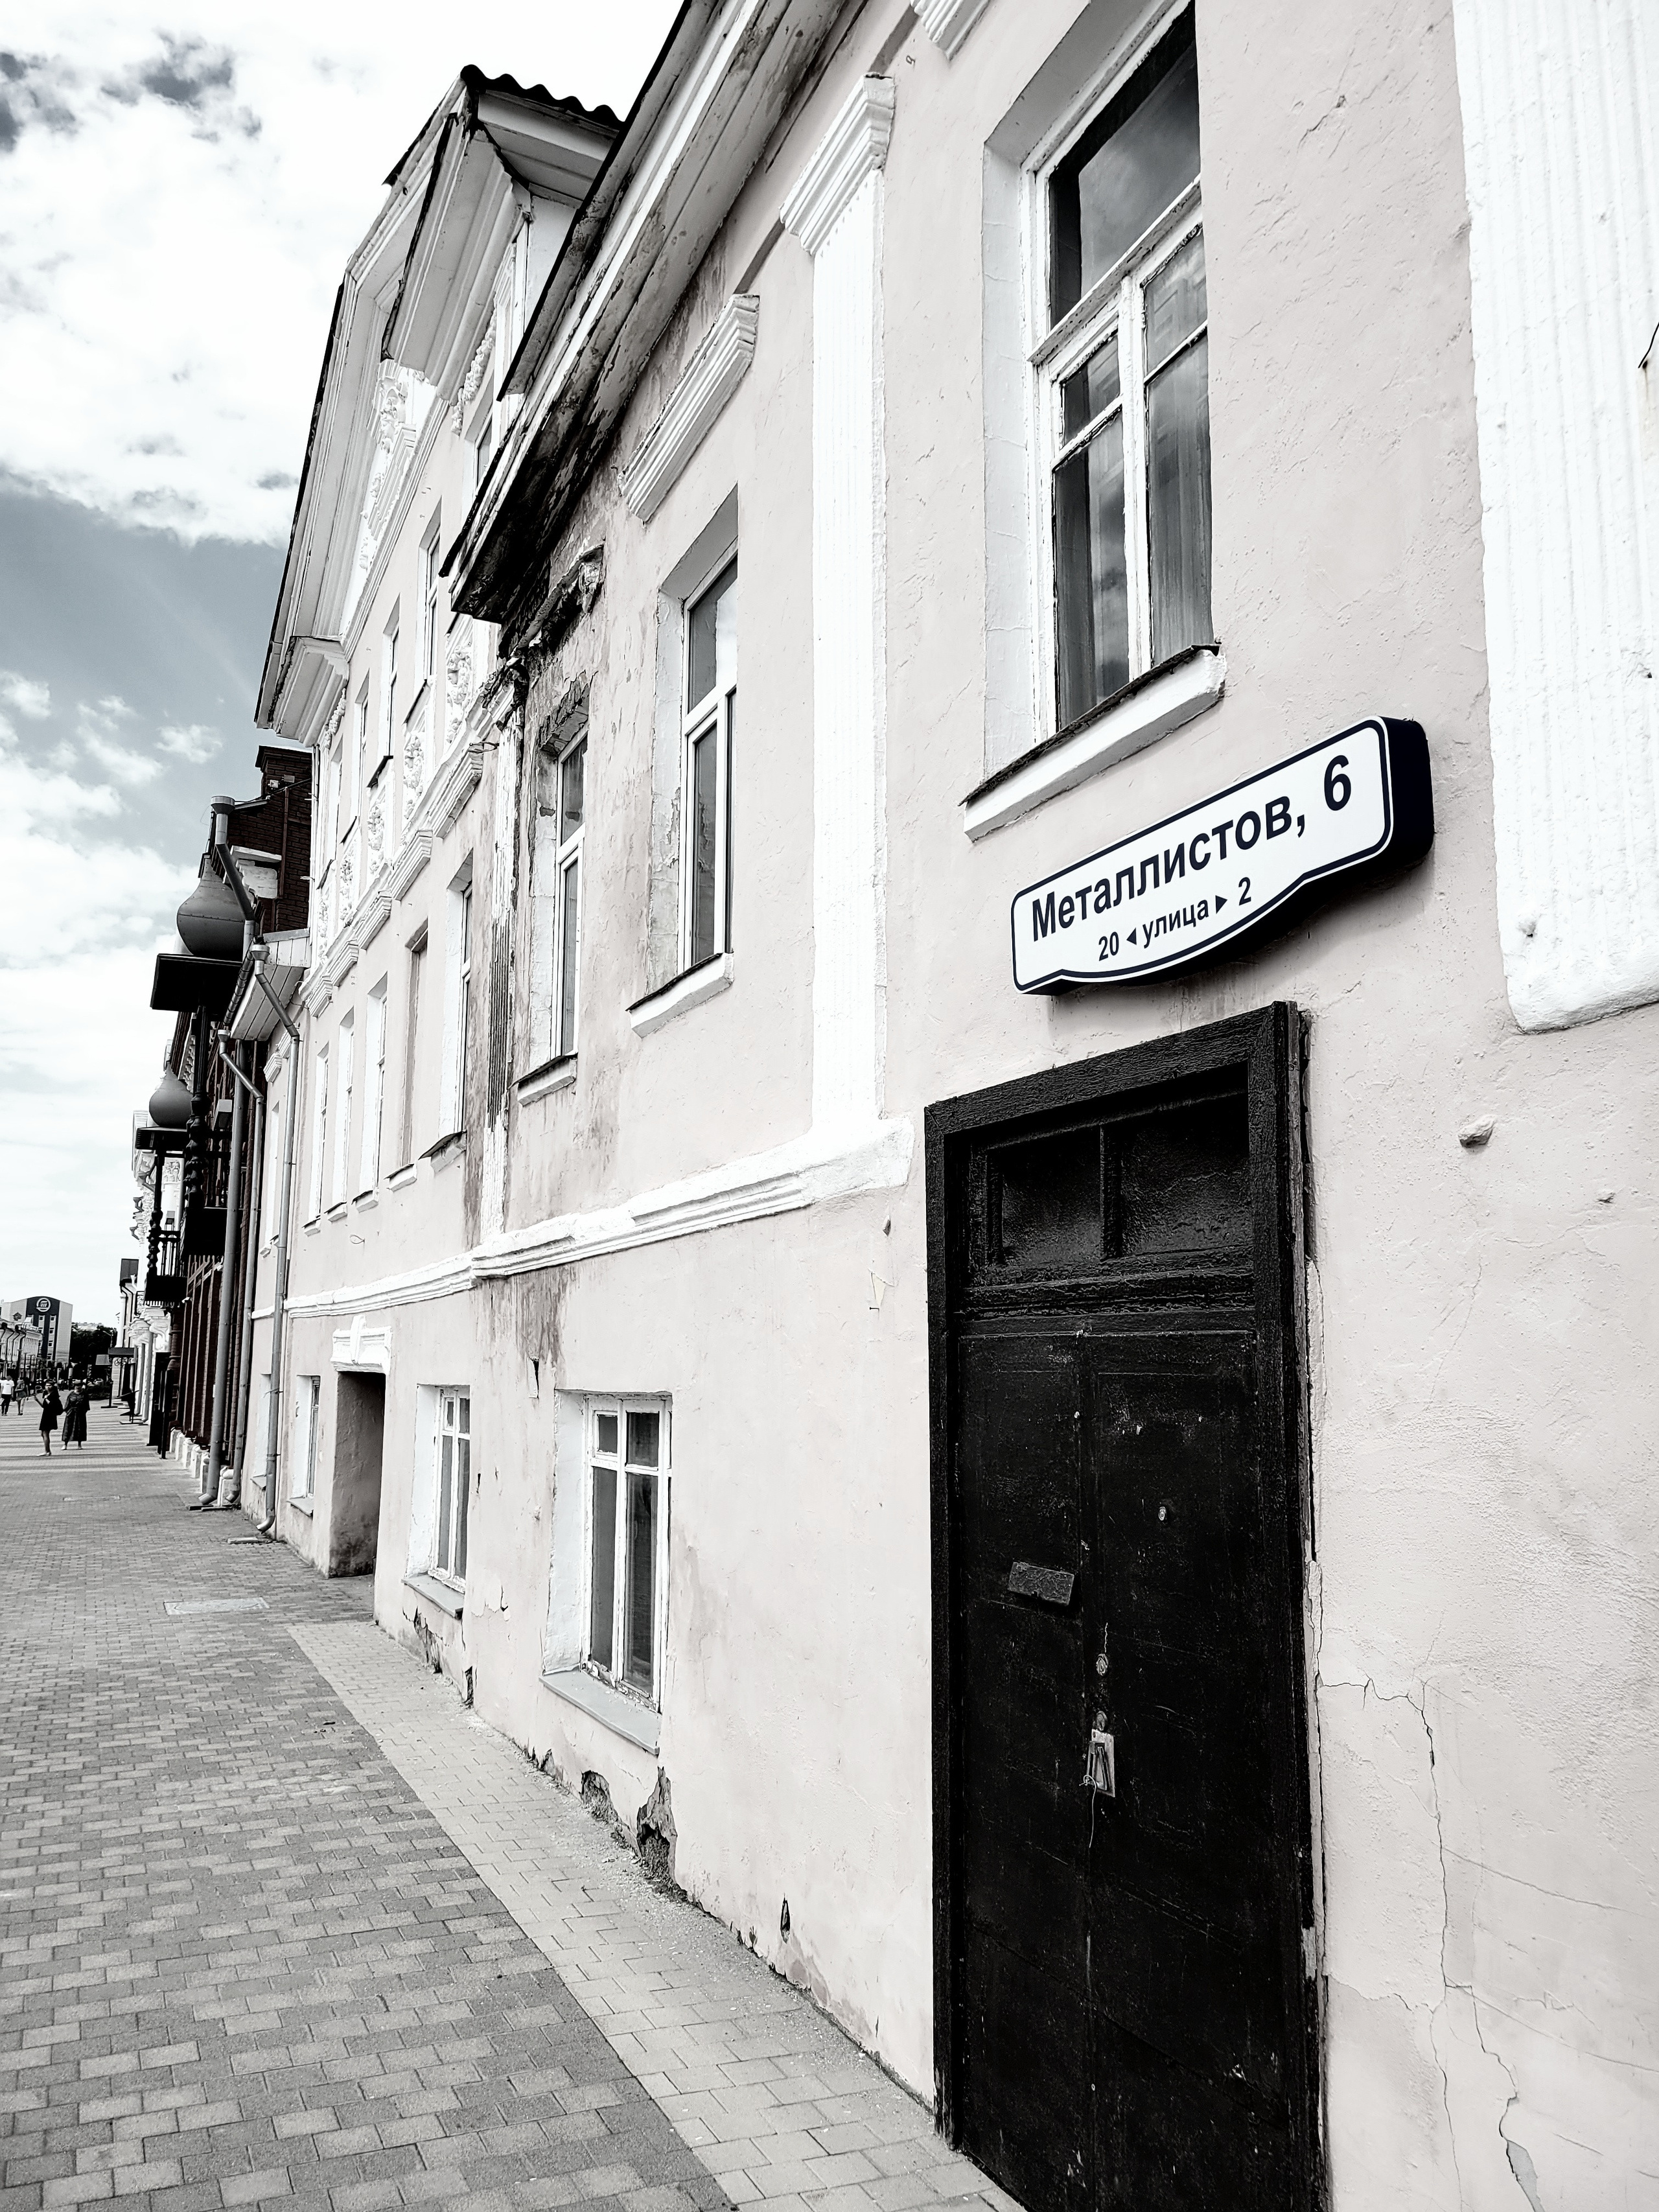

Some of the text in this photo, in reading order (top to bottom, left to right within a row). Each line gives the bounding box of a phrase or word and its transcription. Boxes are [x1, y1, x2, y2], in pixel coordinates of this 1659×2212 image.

[1032, 754, 1352, 942] Металлистов, 6
[1098, 876, 1251, 962] 20 улица 2
